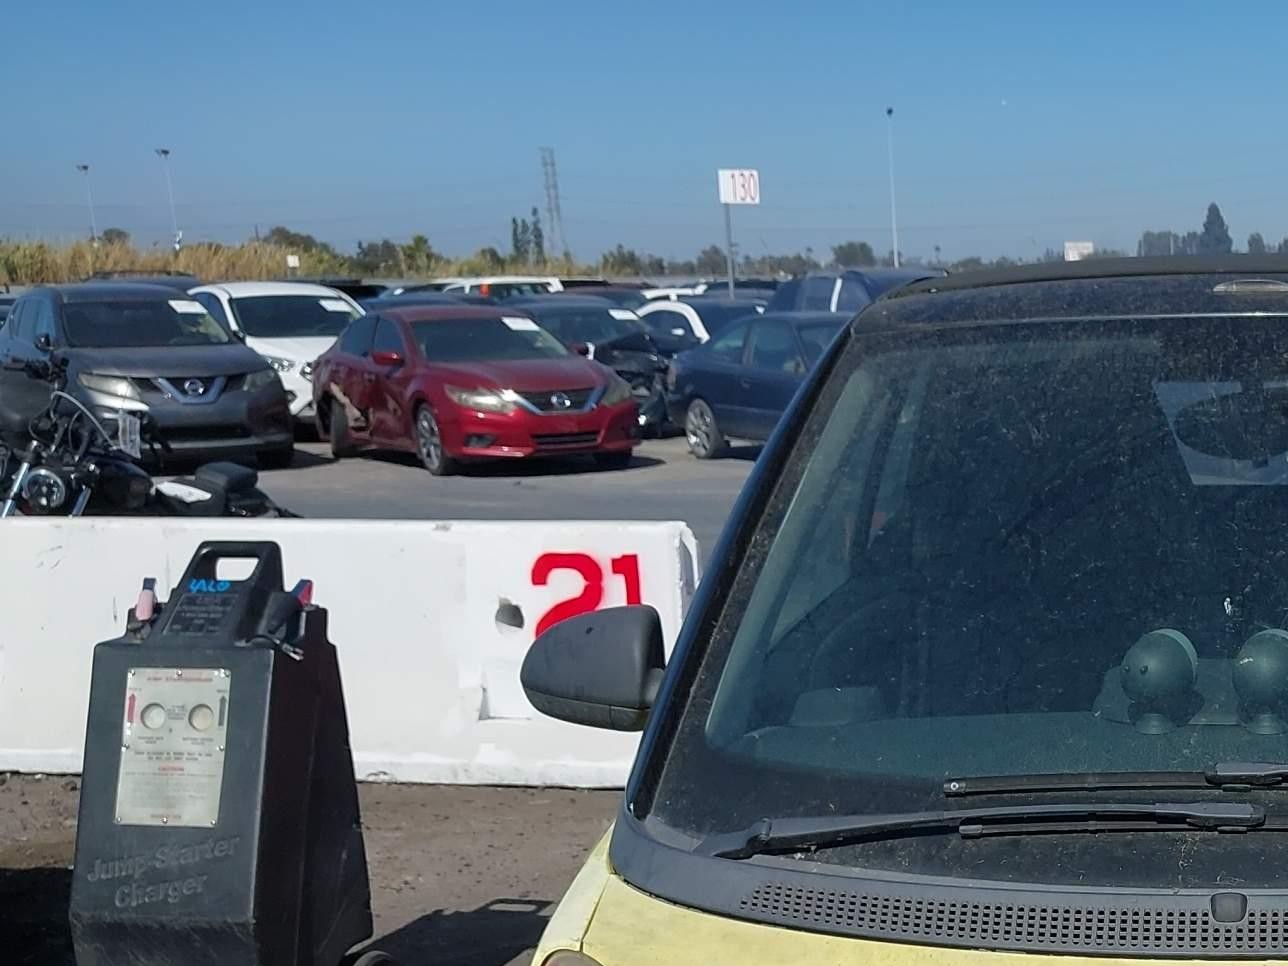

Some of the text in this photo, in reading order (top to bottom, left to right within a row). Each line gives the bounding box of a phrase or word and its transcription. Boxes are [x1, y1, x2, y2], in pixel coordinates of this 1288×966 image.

[731, 172, 758, 201] 130
[532, 553, 642, 638] 21
[114, 874, 209, 908] Charger
